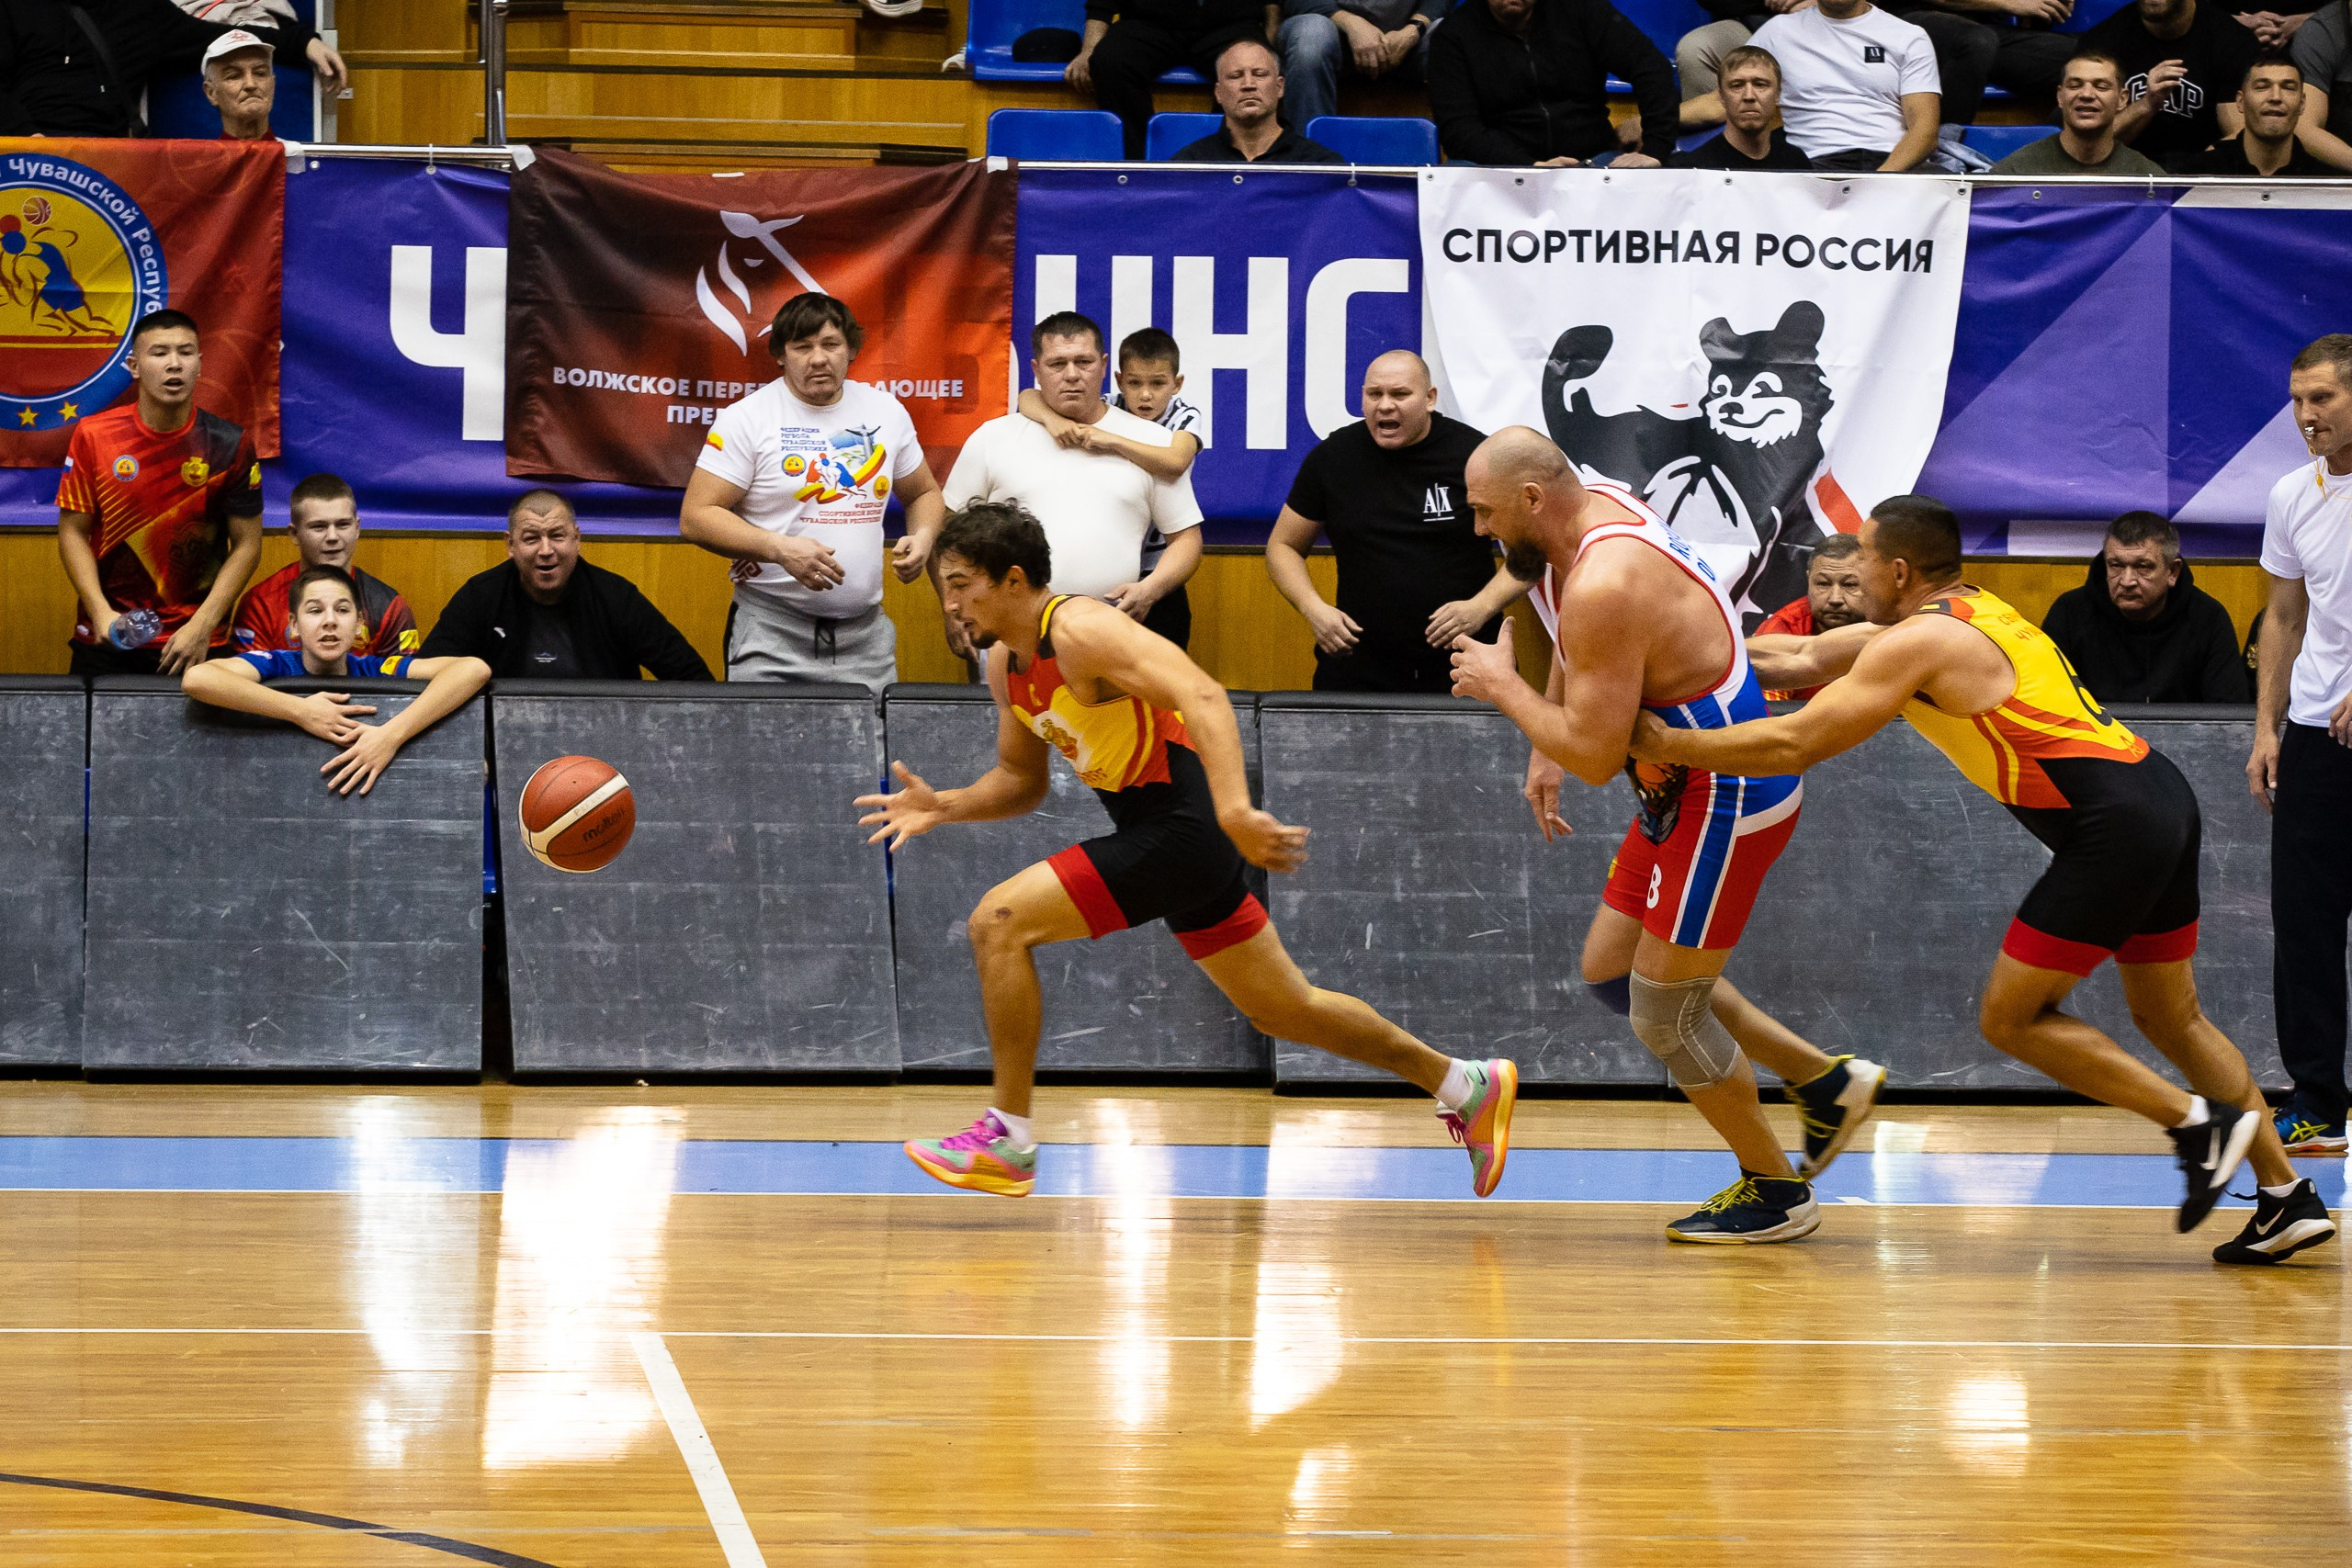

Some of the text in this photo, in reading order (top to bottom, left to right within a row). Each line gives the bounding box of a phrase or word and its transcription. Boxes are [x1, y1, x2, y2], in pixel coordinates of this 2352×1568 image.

[2125, 73, 2204, 118] GP
[8, 157, 140, 226] Чувашской
[1442, 228, 1934, 274] СПОРТИВНАЯ РОССИЯ
[552, 367, 690, 397] ВОЛЖСКОЕ
